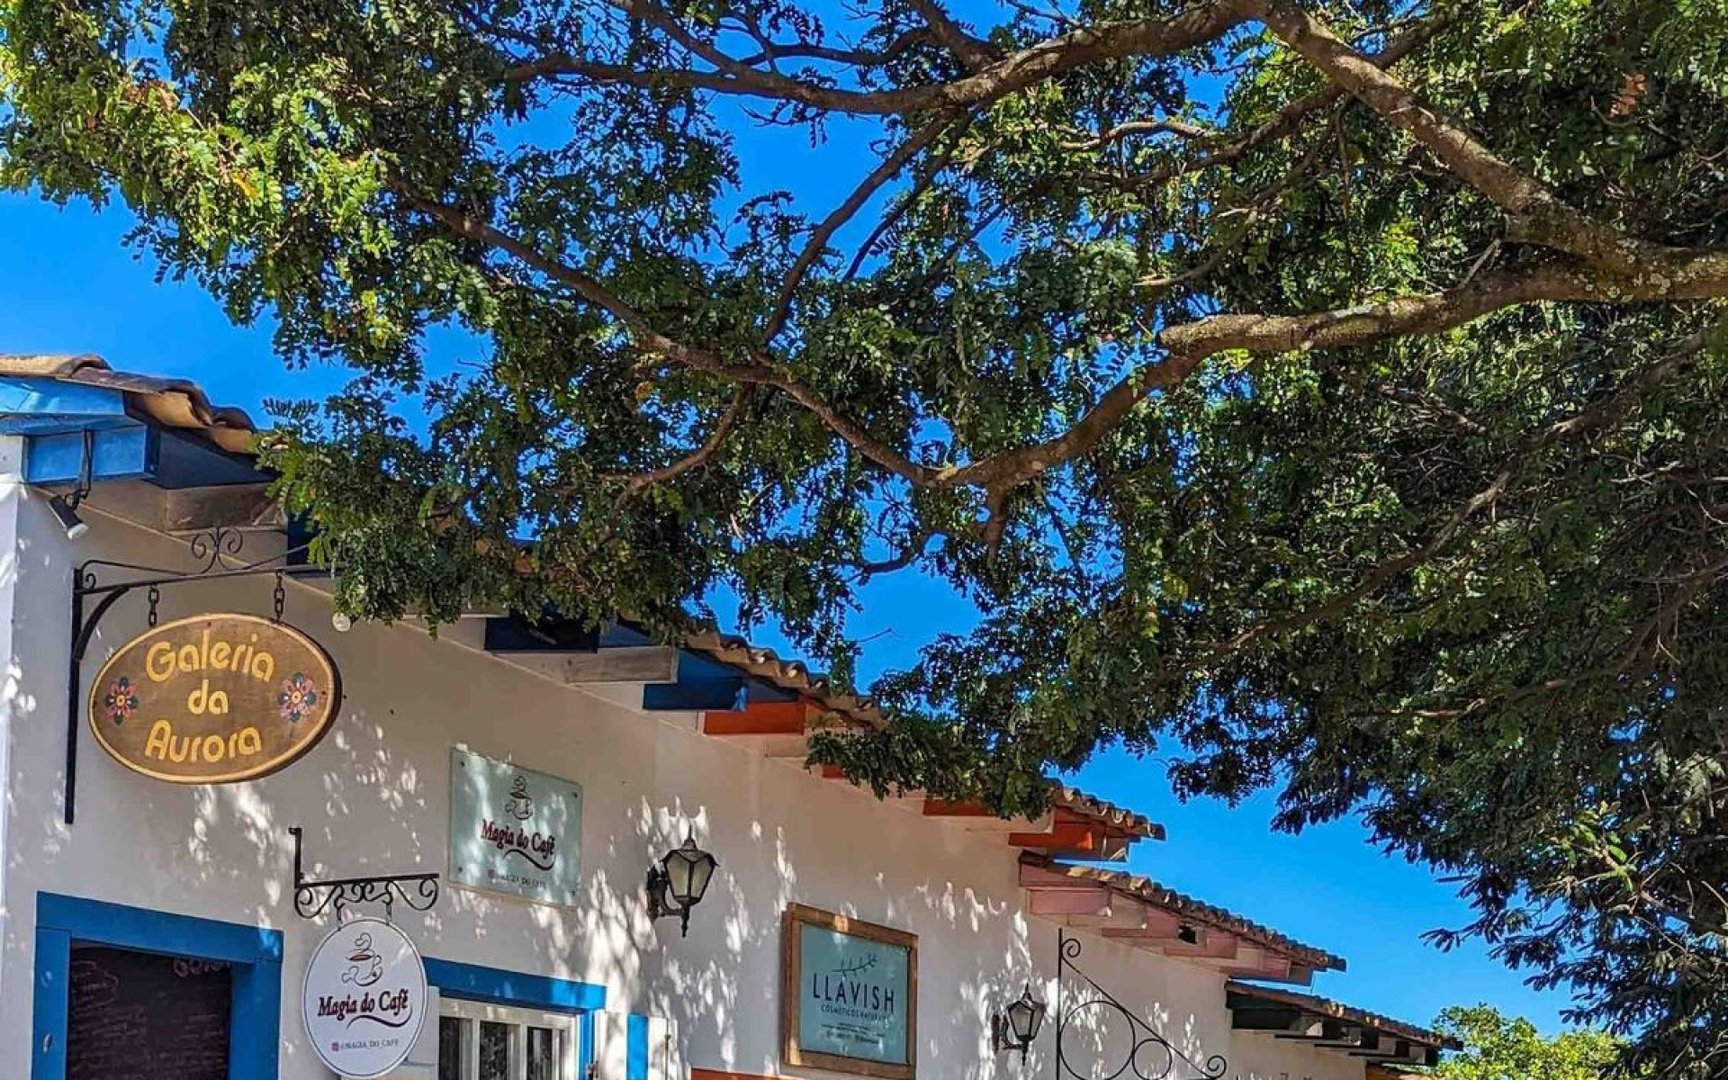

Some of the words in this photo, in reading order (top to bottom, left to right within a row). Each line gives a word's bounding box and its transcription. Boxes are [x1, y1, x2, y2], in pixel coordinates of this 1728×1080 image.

[146, 629, 275, 683] Galeria
[187, 679, 230, 715] da
[144, 719, 263, 763] Aurora
[481, 818, 515, 849] Magia
[516, 828, 529, 849] do
[532, 832, 555, 860] Café
[317, 994, 357, 1021] Magia
[360, 992, 375, 1013] do
[379, 988, 409, 1016] Café
[813, 973, 894, 1014] LLAVISH
